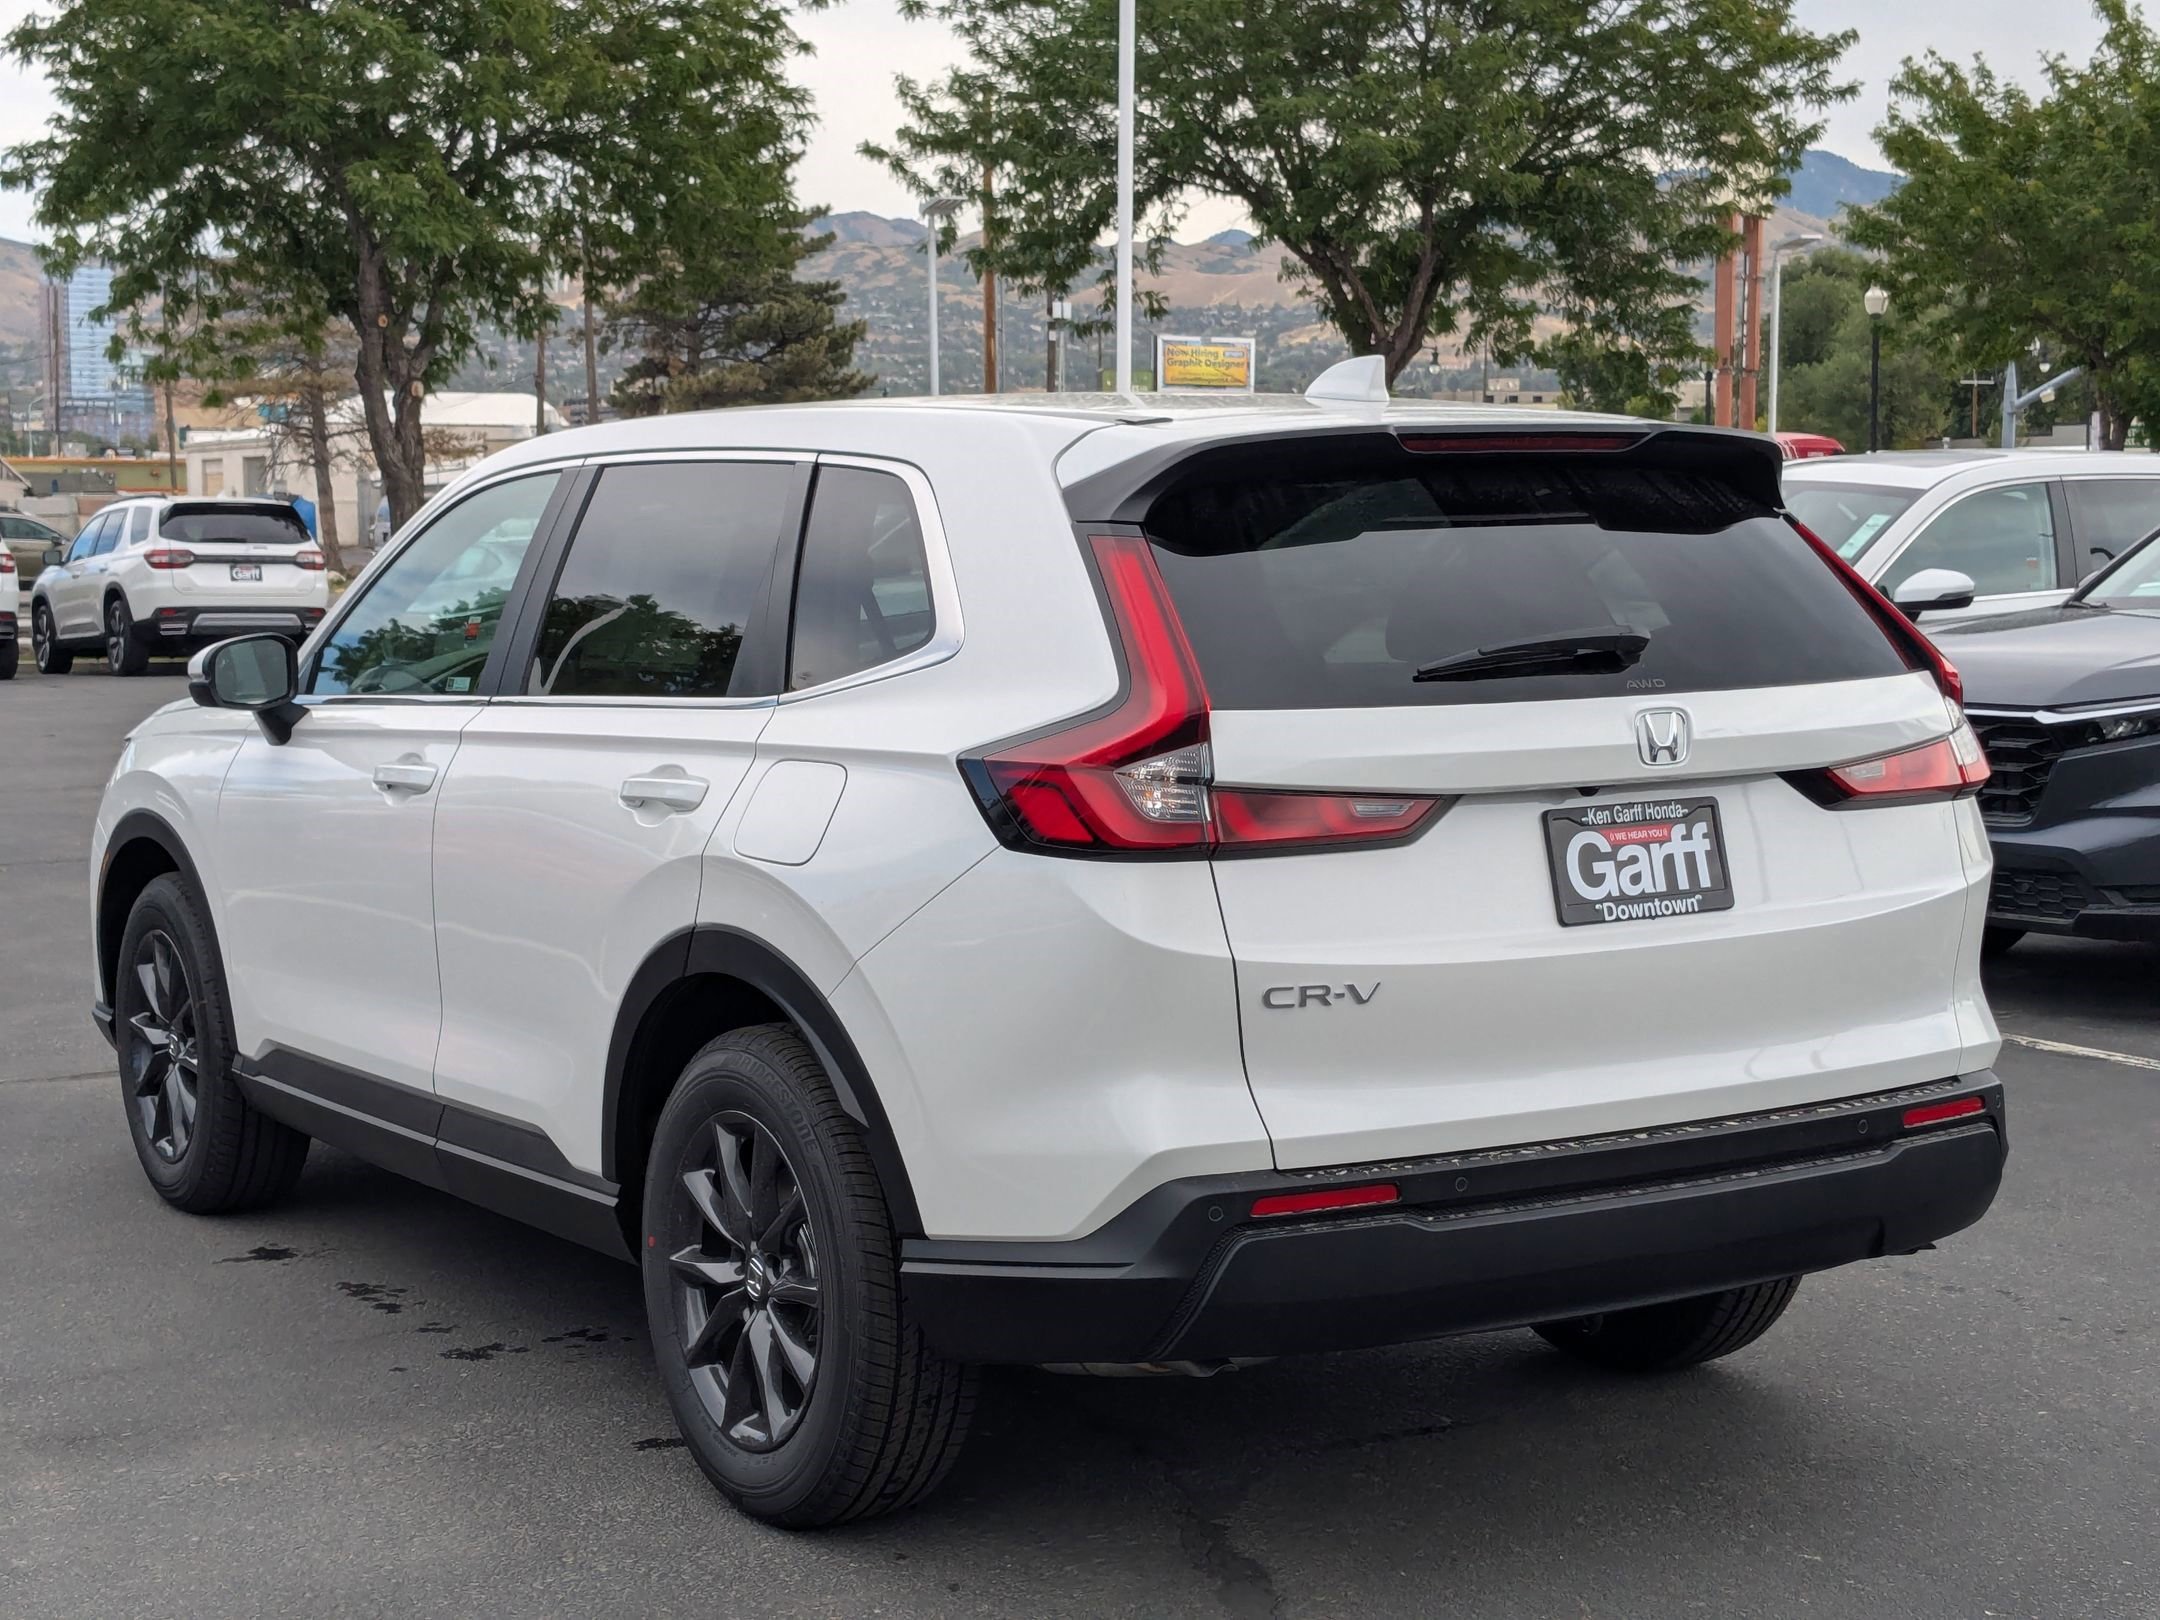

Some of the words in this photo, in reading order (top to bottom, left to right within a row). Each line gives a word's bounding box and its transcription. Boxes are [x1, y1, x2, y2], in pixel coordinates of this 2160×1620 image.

[1167, 348, 1189, 357] Now
[1190, 348, 1219, 360] Hiring
[1167, 358, 1202, 368] Graphic
[1205, 359, 1245, 370] Designer
[1626, 678, 1666, 689] AWD
[1587, 807, 1612, 825] Ken
[1613, 803, 1644, 823] Garff
[1646, 802, 1683, 821] Honda
[1614, 832, 1627, 841] WE
[1628, 830, 1648, 840] HEAR
[1648, 829, 1663, 839] YOU
[1566, 821, 1712, 901] Garff
[1602, 898, 1700, 922] Downtown
[1261, 981, 1381, 1009] CR-V
[726, 1051, 818, 1155] BRIDGESTONE
